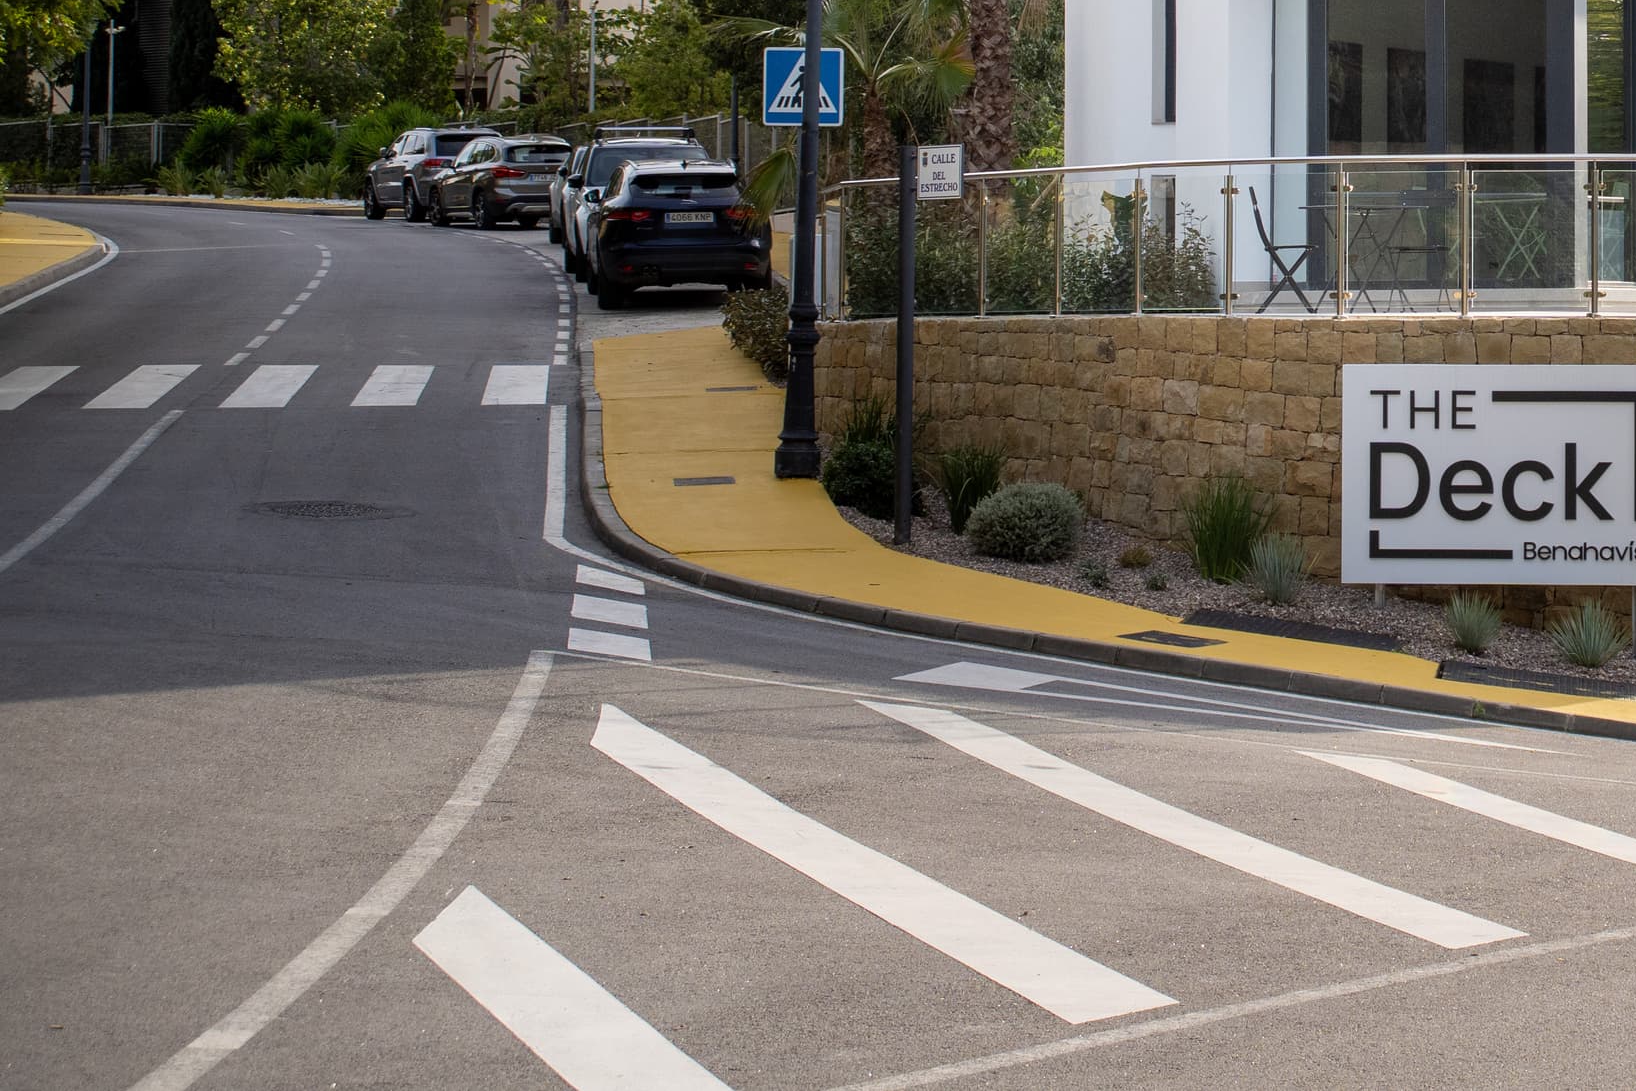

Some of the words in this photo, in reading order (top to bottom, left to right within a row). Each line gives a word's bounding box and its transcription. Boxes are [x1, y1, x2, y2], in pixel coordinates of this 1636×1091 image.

[931, 153, 956, 164] CALLE
[932, 171, 946, 181] DEL
[920, 182, 958, 193] ESTRECHO
[1369, 389, 1477, 430] THE
[1368, 441, 1616, 522] Deck
